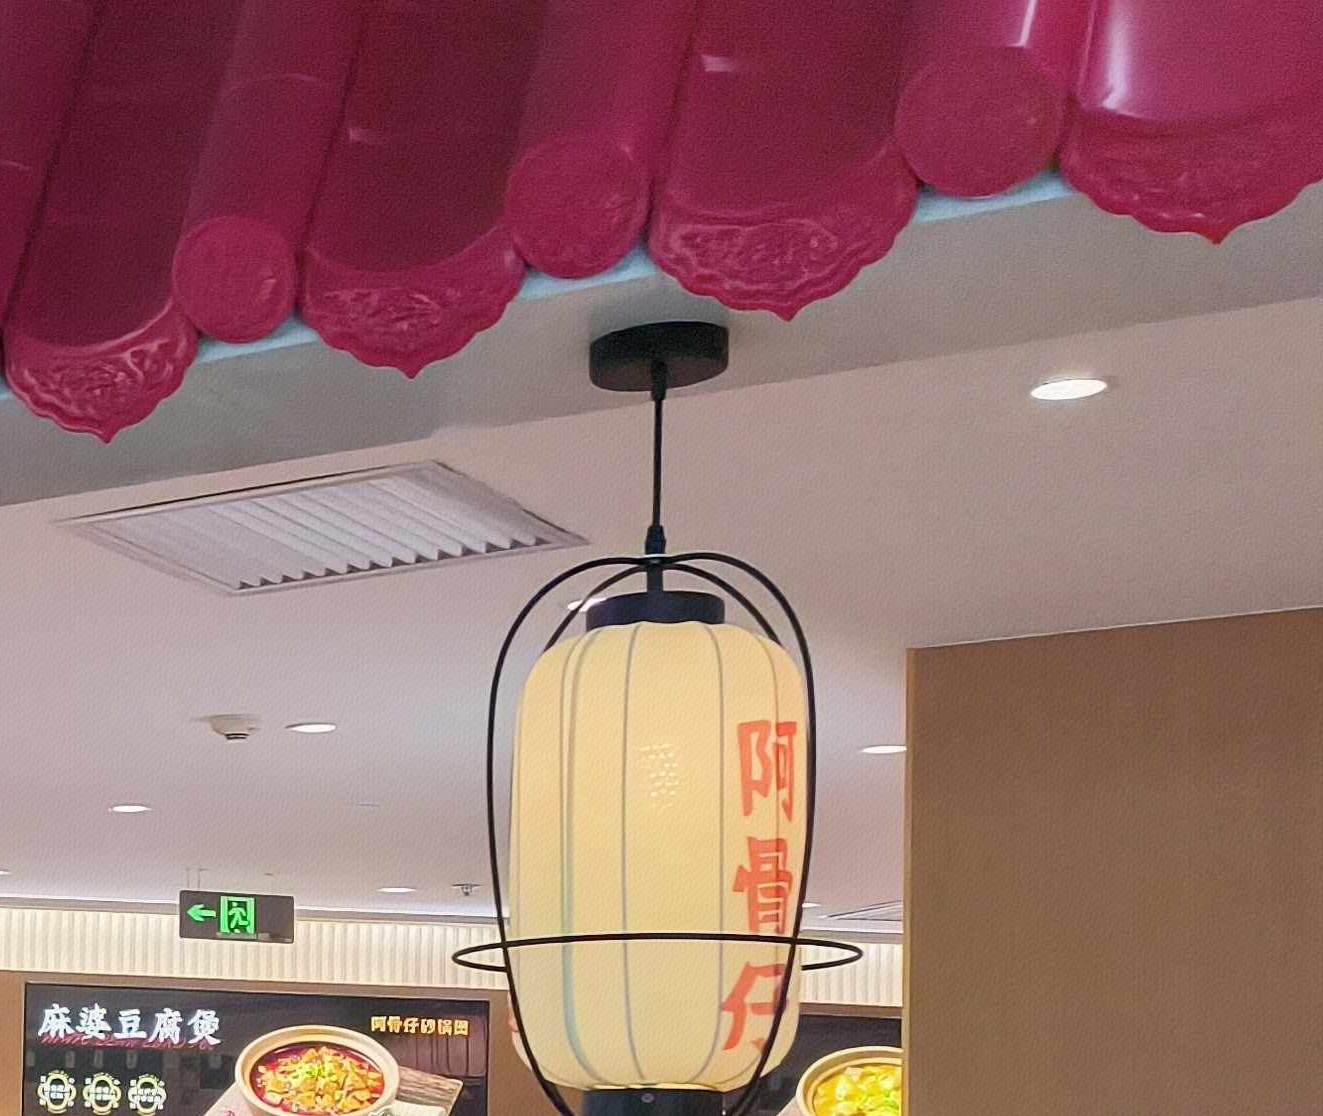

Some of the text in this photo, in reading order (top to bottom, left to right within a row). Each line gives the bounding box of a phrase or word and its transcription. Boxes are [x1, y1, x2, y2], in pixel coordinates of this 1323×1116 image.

[720, 720, 797, 1050] 阿骨仔
[38, 1003, 222, 1045] 麻婆豆腐煲
